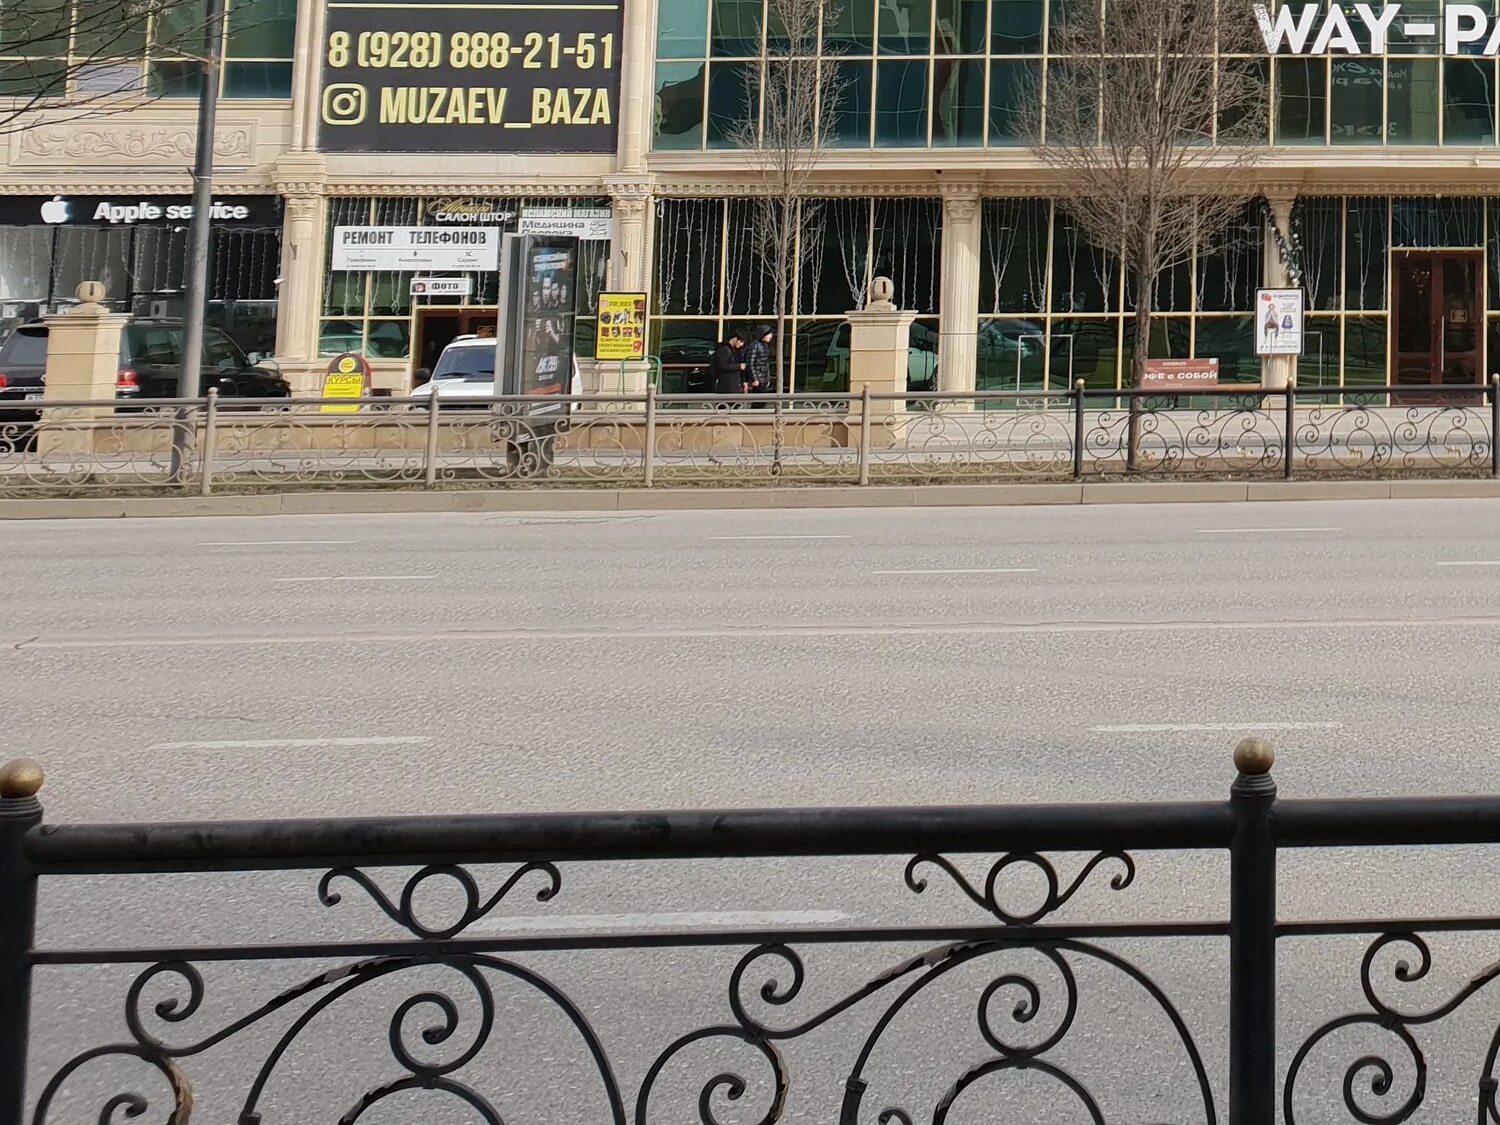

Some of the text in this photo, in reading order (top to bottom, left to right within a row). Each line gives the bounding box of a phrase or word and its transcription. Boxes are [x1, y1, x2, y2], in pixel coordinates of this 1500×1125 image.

[328, 30, 614, 70] 8 (928) 888-21-51
[379, 86, 612, 129] MUZAEV_BAZA
[93, 202, 250, 221] Apple sevice
[435, 212, 513, 223] САЛОН ШТОР
[522, 220, 585, 229] Медицина
[342, 231, 487, 245] РЕМОНТ ТЕЛЕФОНОВ
[328, 375, 361, 384] КУРСЫ
[1177, 370, 1218, 380] СОБОЙ
